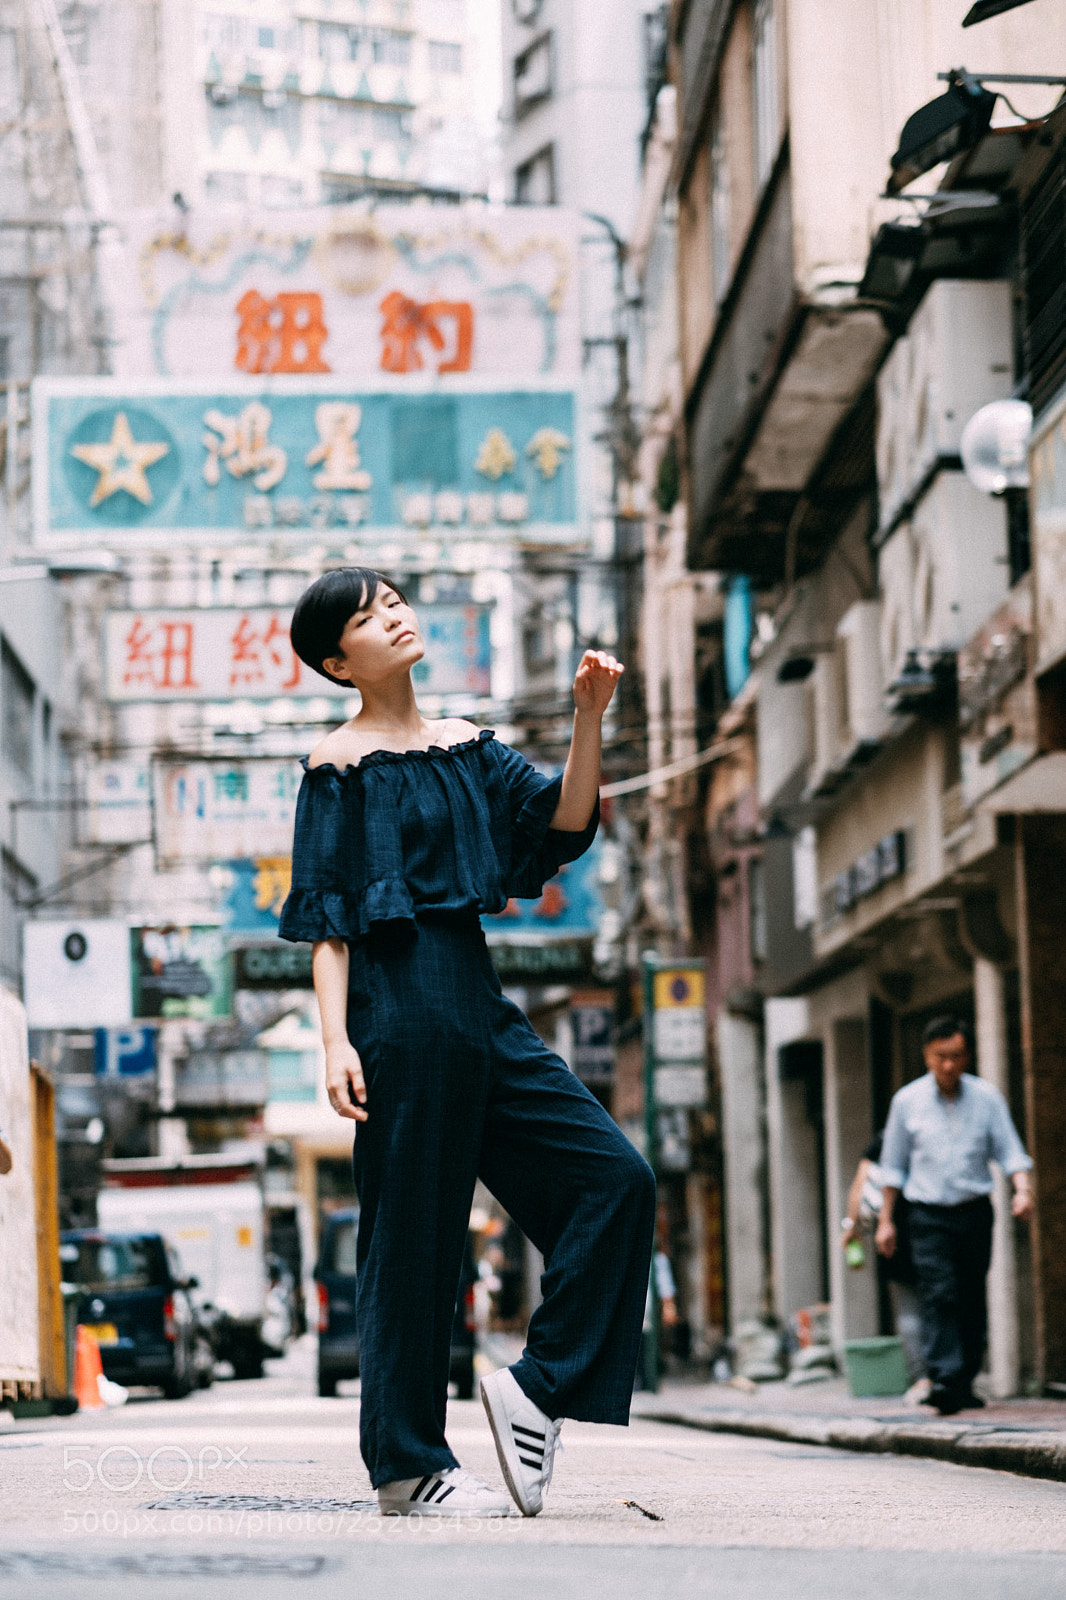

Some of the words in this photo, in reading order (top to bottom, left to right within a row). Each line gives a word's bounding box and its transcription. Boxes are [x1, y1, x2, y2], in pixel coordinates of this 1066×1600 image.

[234, 289, 474, 375] 紐約
[203, 401, 372, 491] 鴻星
[122, 612, 302, 689] 紐約
